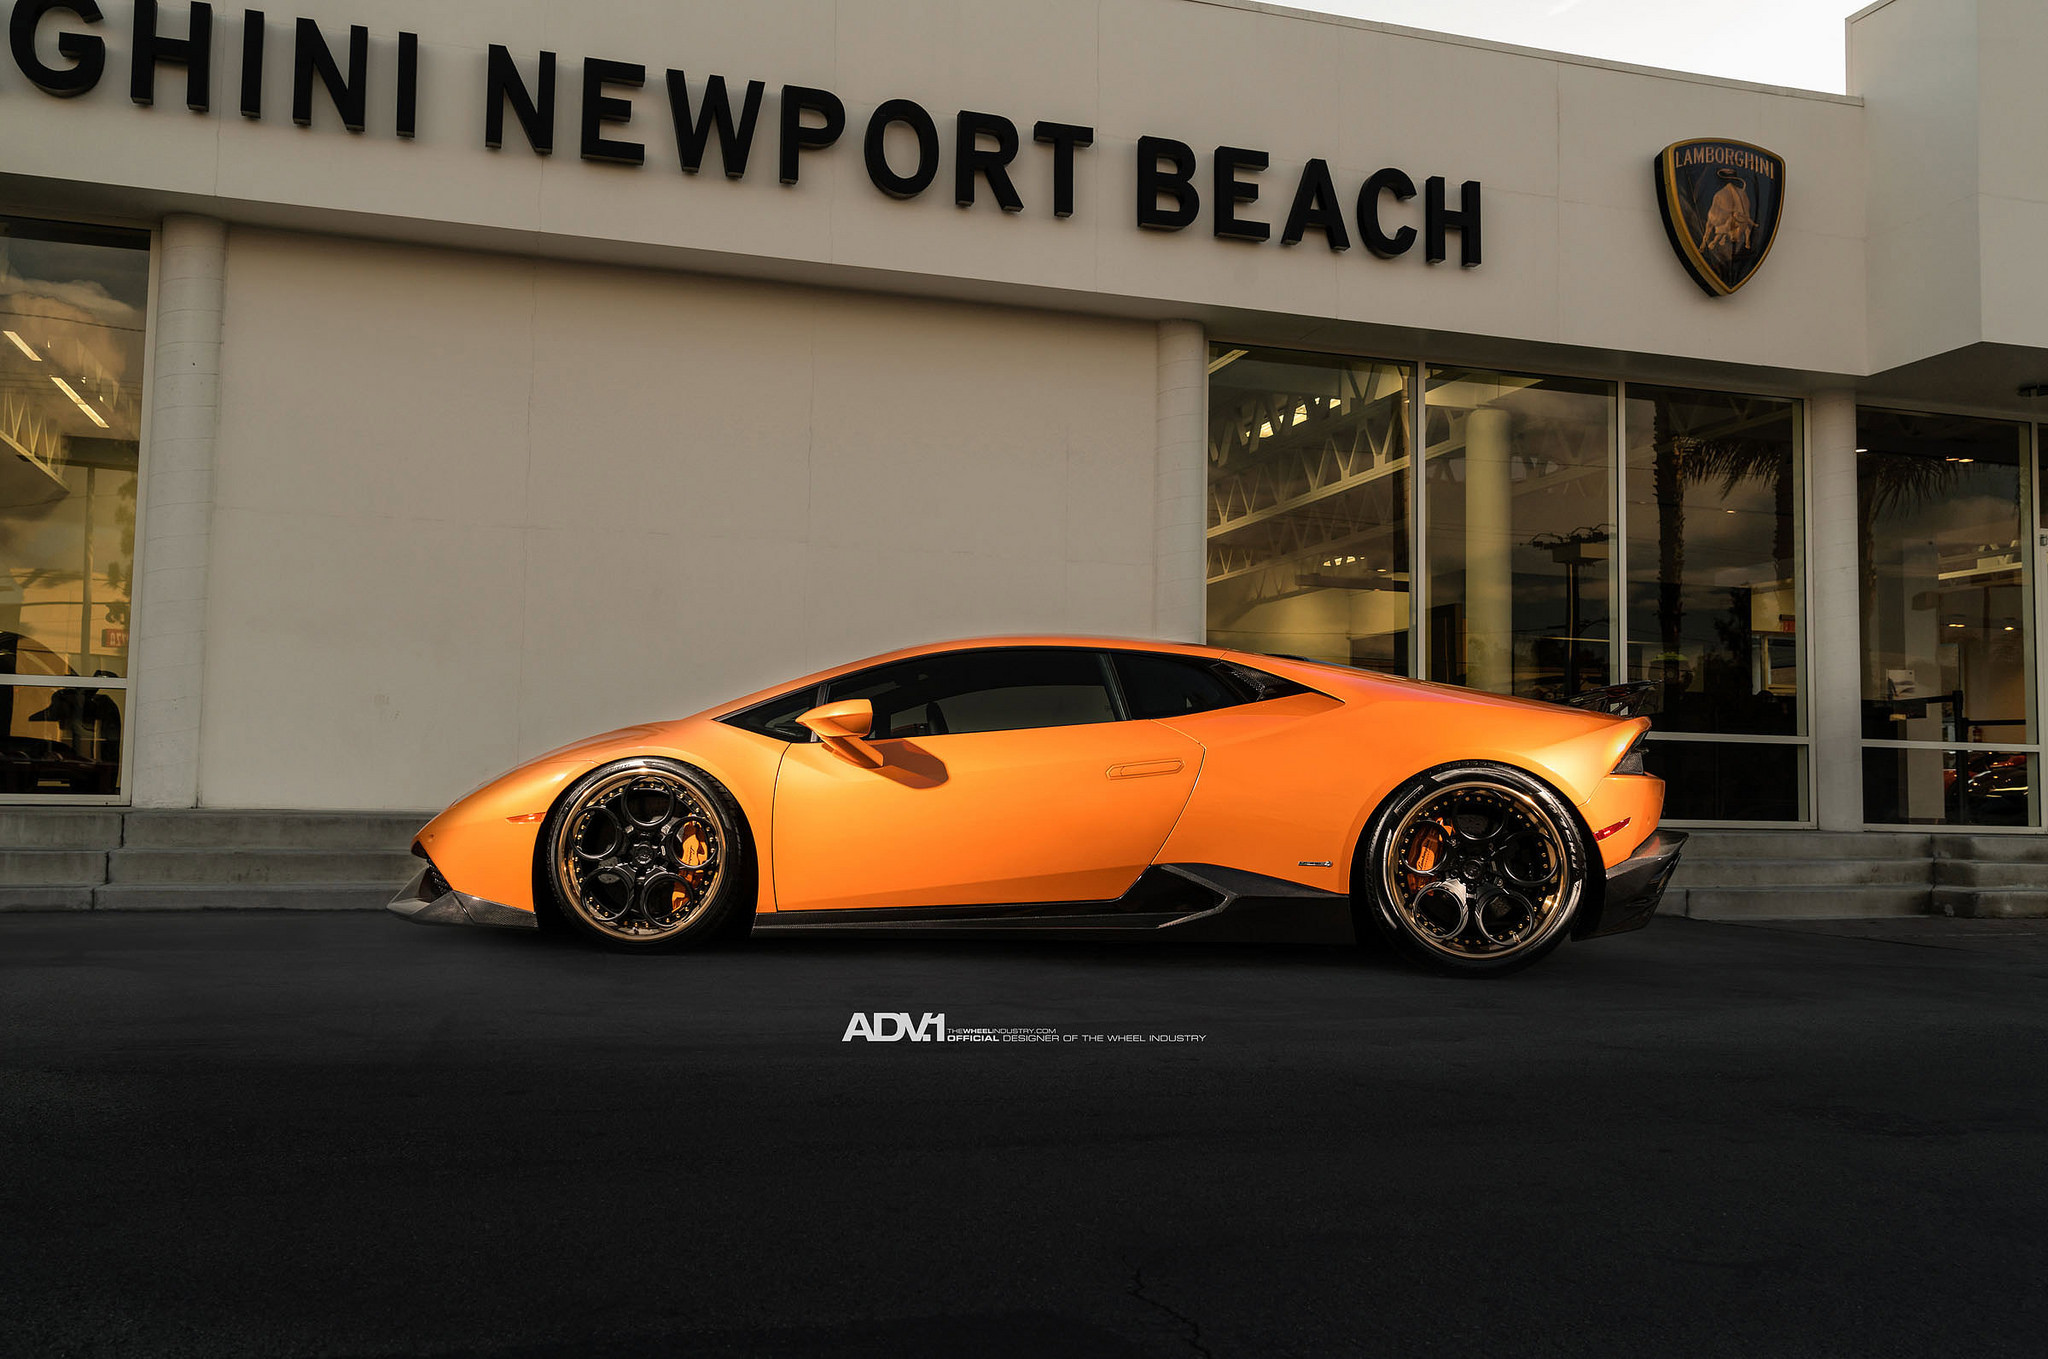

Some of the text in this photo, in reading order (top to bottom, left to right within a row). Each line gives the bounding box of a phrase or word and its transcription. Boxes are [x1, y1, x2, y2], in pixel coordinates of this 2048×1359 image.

[9, 0, 1482, 268] GHINI NEWPORT BEACH
[1675, 146, 1775, 180] LAMBORGHINI
